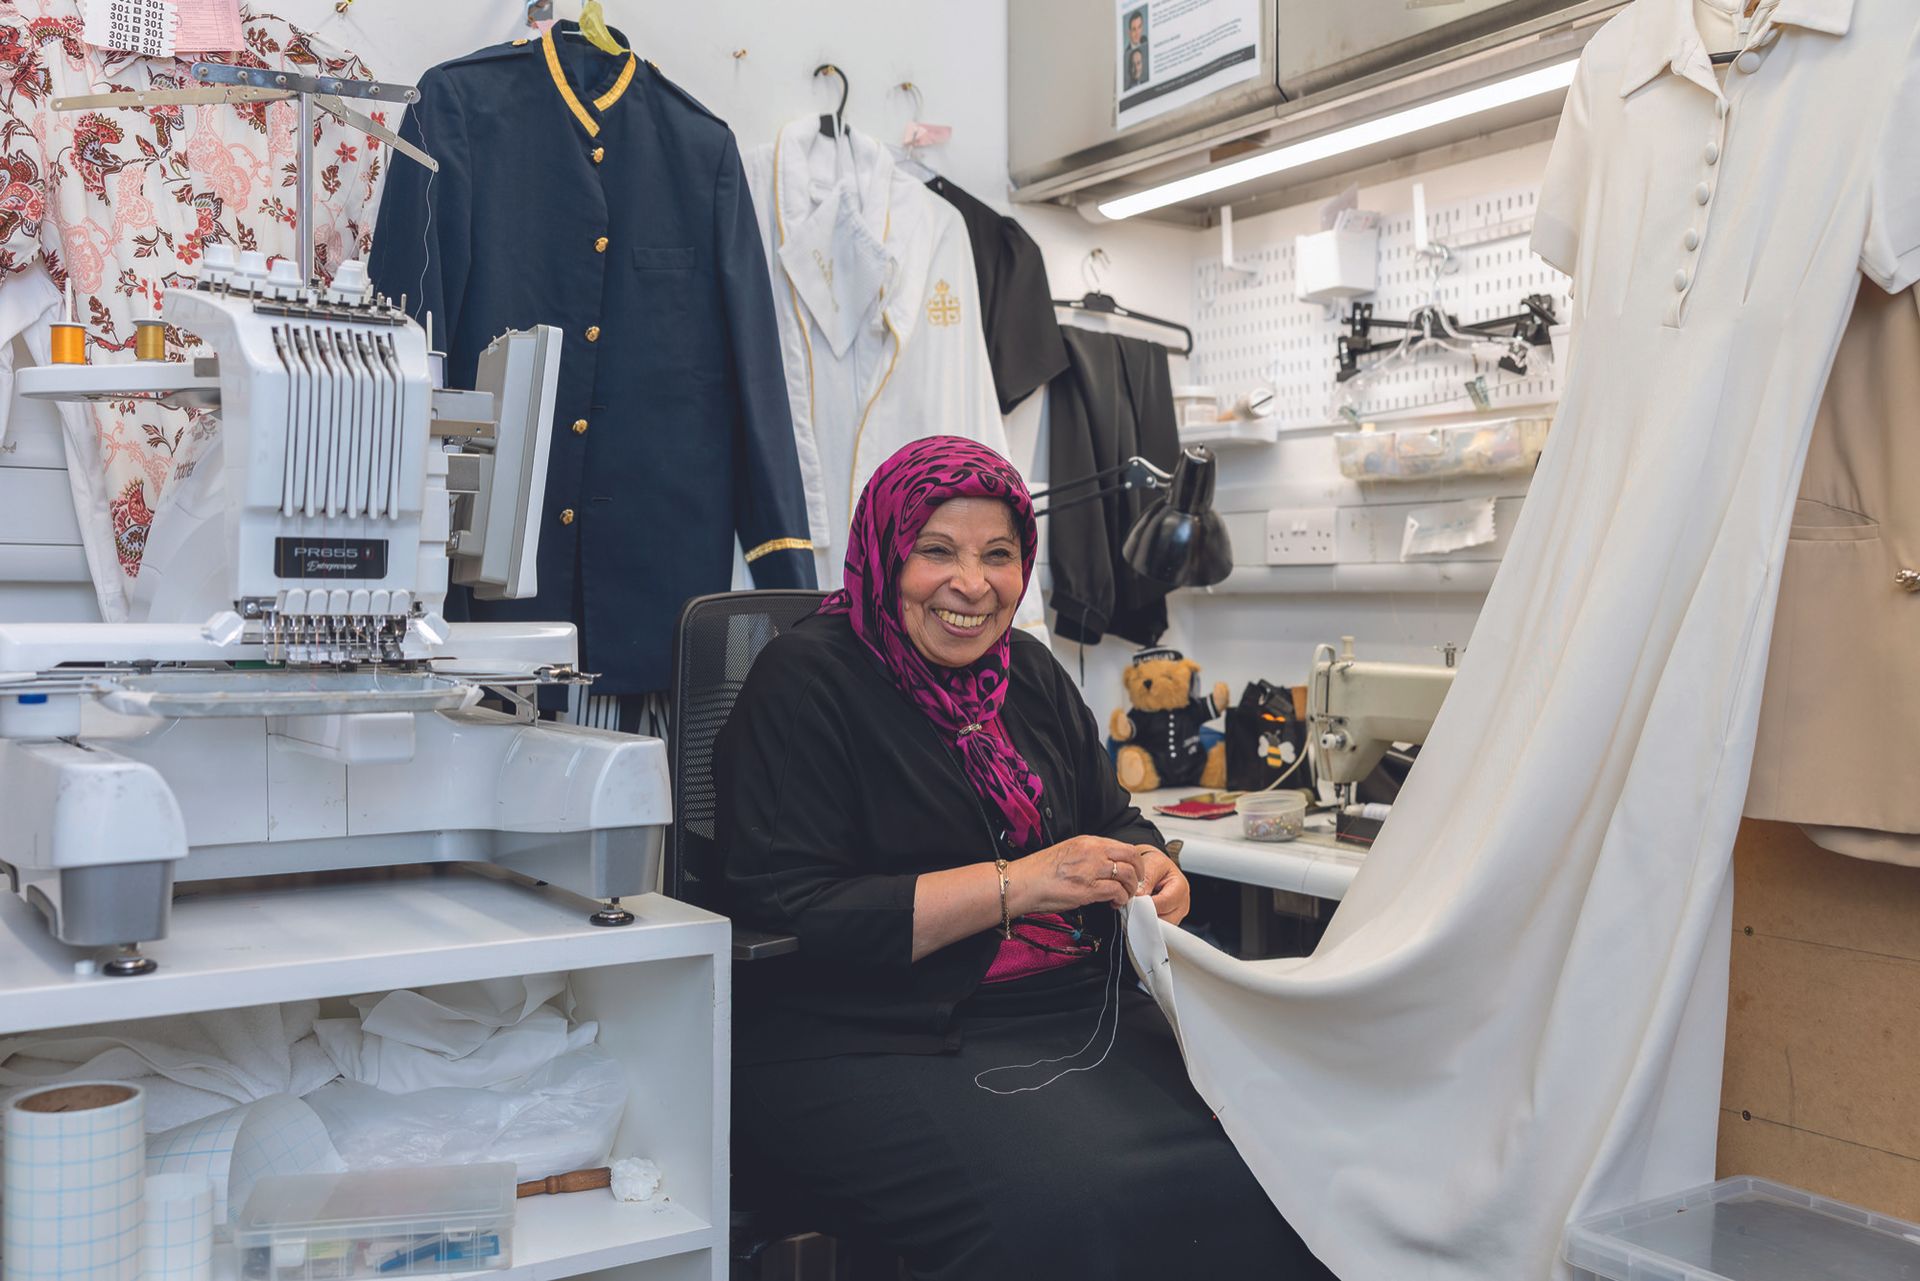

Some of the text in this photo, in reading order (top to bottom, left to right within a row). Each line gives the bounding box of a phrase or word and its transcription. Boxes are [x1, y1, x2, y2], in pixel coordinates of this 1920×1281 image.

[111, 3, 130, 14] 301
[145, 10, 163, 21] 301
[146, 0, 165, 11] 301
[110, 12, 129, 23] 301
[144, 19, 163, 30] 301
[111, 21, 130, 32] 301
[145, 28, 164, 39] 301
[108, 40, 127, 50] 301
[142, 46, 161, 56] 301
[109, 31, 128, 42] 301
[143, 38, 162, 49] 301
[294, 547, 358, 558] PR655
[306, 560, 357, 572] Entrepreneur
